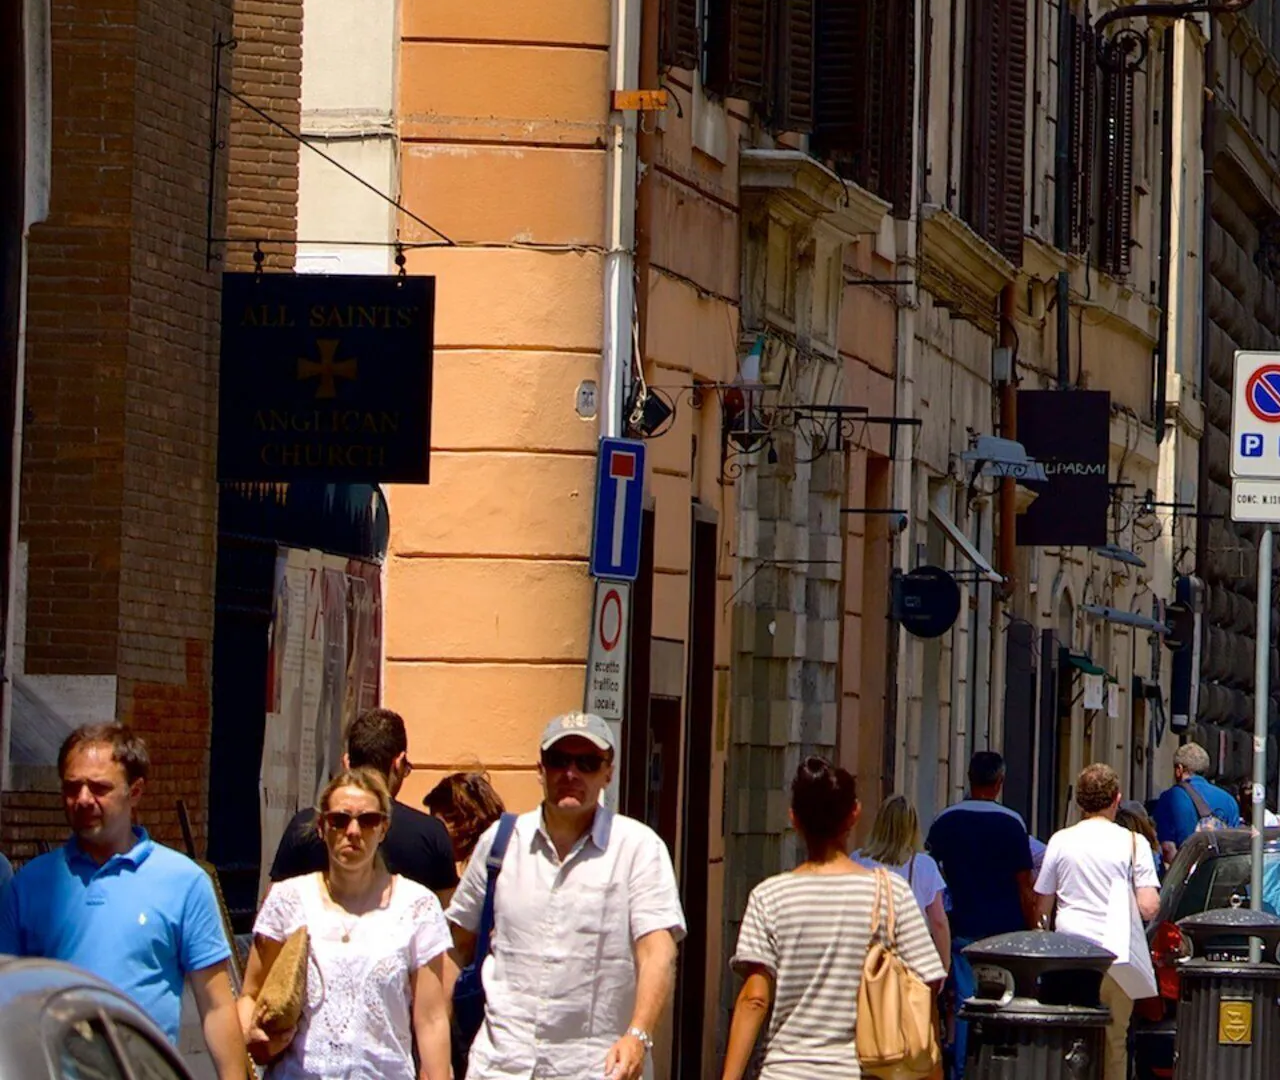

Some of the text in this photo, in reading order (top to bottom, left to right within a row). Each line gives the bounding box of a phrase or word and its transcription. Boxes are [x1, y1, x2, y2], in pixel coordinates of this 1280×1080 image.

[239, 303, 295, 327] ALL
[253, 409, 400, 433] ANGLICAN
[259, 442, 387, 467] CHURCH
